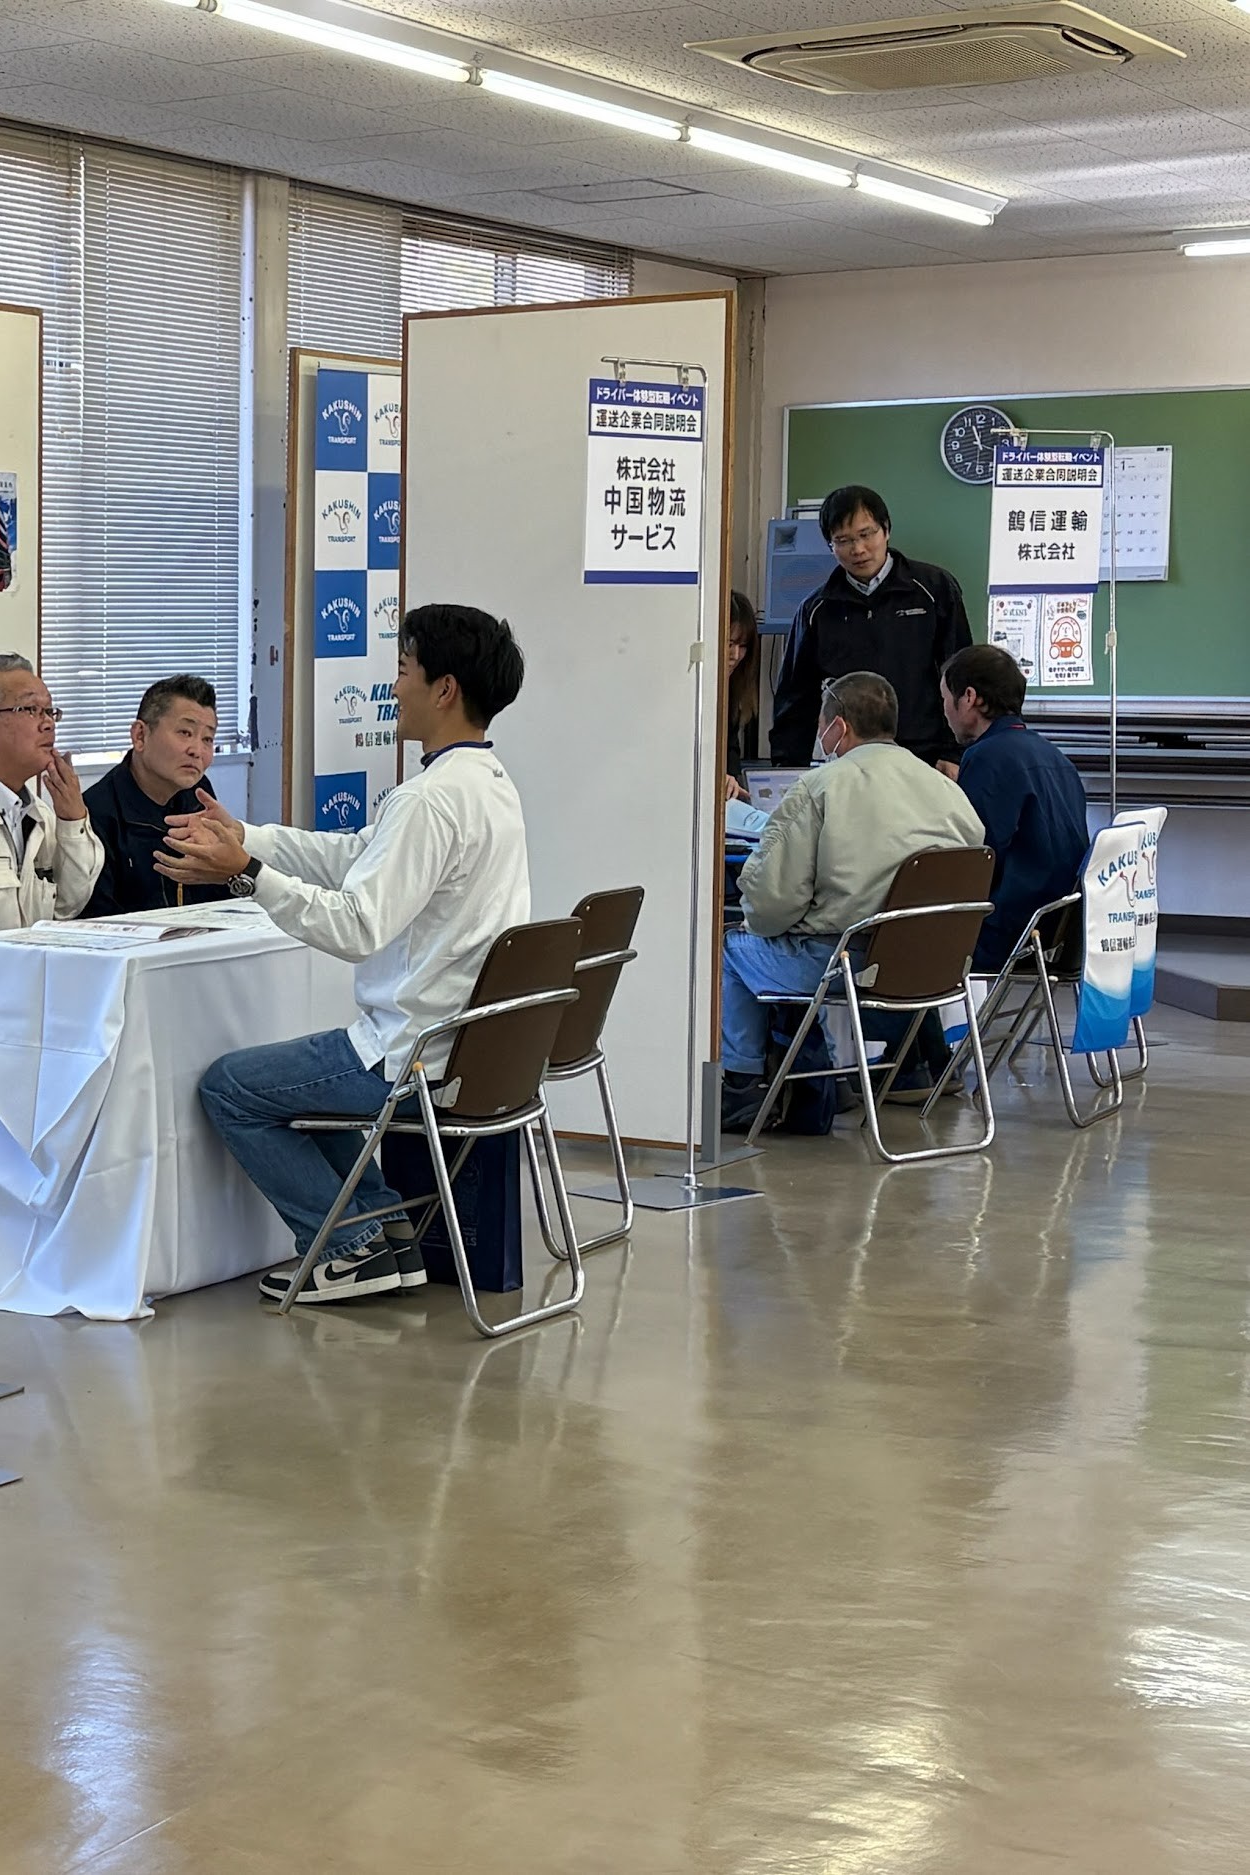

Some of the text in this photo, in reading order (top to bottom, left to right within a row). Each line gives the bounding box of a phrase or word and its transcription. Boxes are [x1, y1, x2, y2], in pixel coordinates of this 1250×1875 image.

[322, 399, 362, 422] KAKUSHIN
[374, 403, 401, 423] KAKUS
[975, 414, 986, 424] 12
[596, 409, 697, 433] 運送企業合同説明会
[964, 416, 971, 427] 11
[991, 416, 996, 426] 1
[327, 436, 356, 444] TRANSPORT
[953, 427, 966, 437] 10
[951, 440, 960, 450] 9
[955, 453, 963, 463] 8
[964, 462, 972, 472] 7
[616, 456, 676, 482] 株式会社
[975, 465, 984, 475] 6
[1001, 467, 1098, 482] 運送企業合同説明会
[321, 499, 361, 520] KAKUSHIN
[604, 485, 686, 517] 中国物流
[1008, 510, 1088, 532] 鶴信運輸
[611, 523, 676, 551] サービス
[1017, 542, 1076, 561] 株式会社
[321, 597, 361, 620] KAKUSHIN
[327, 633, 356, 642] TRANSPORT
[334, 685, 367, 704] KAKUSHIN
[322, 792, 360, 815] KAKUSHIN
